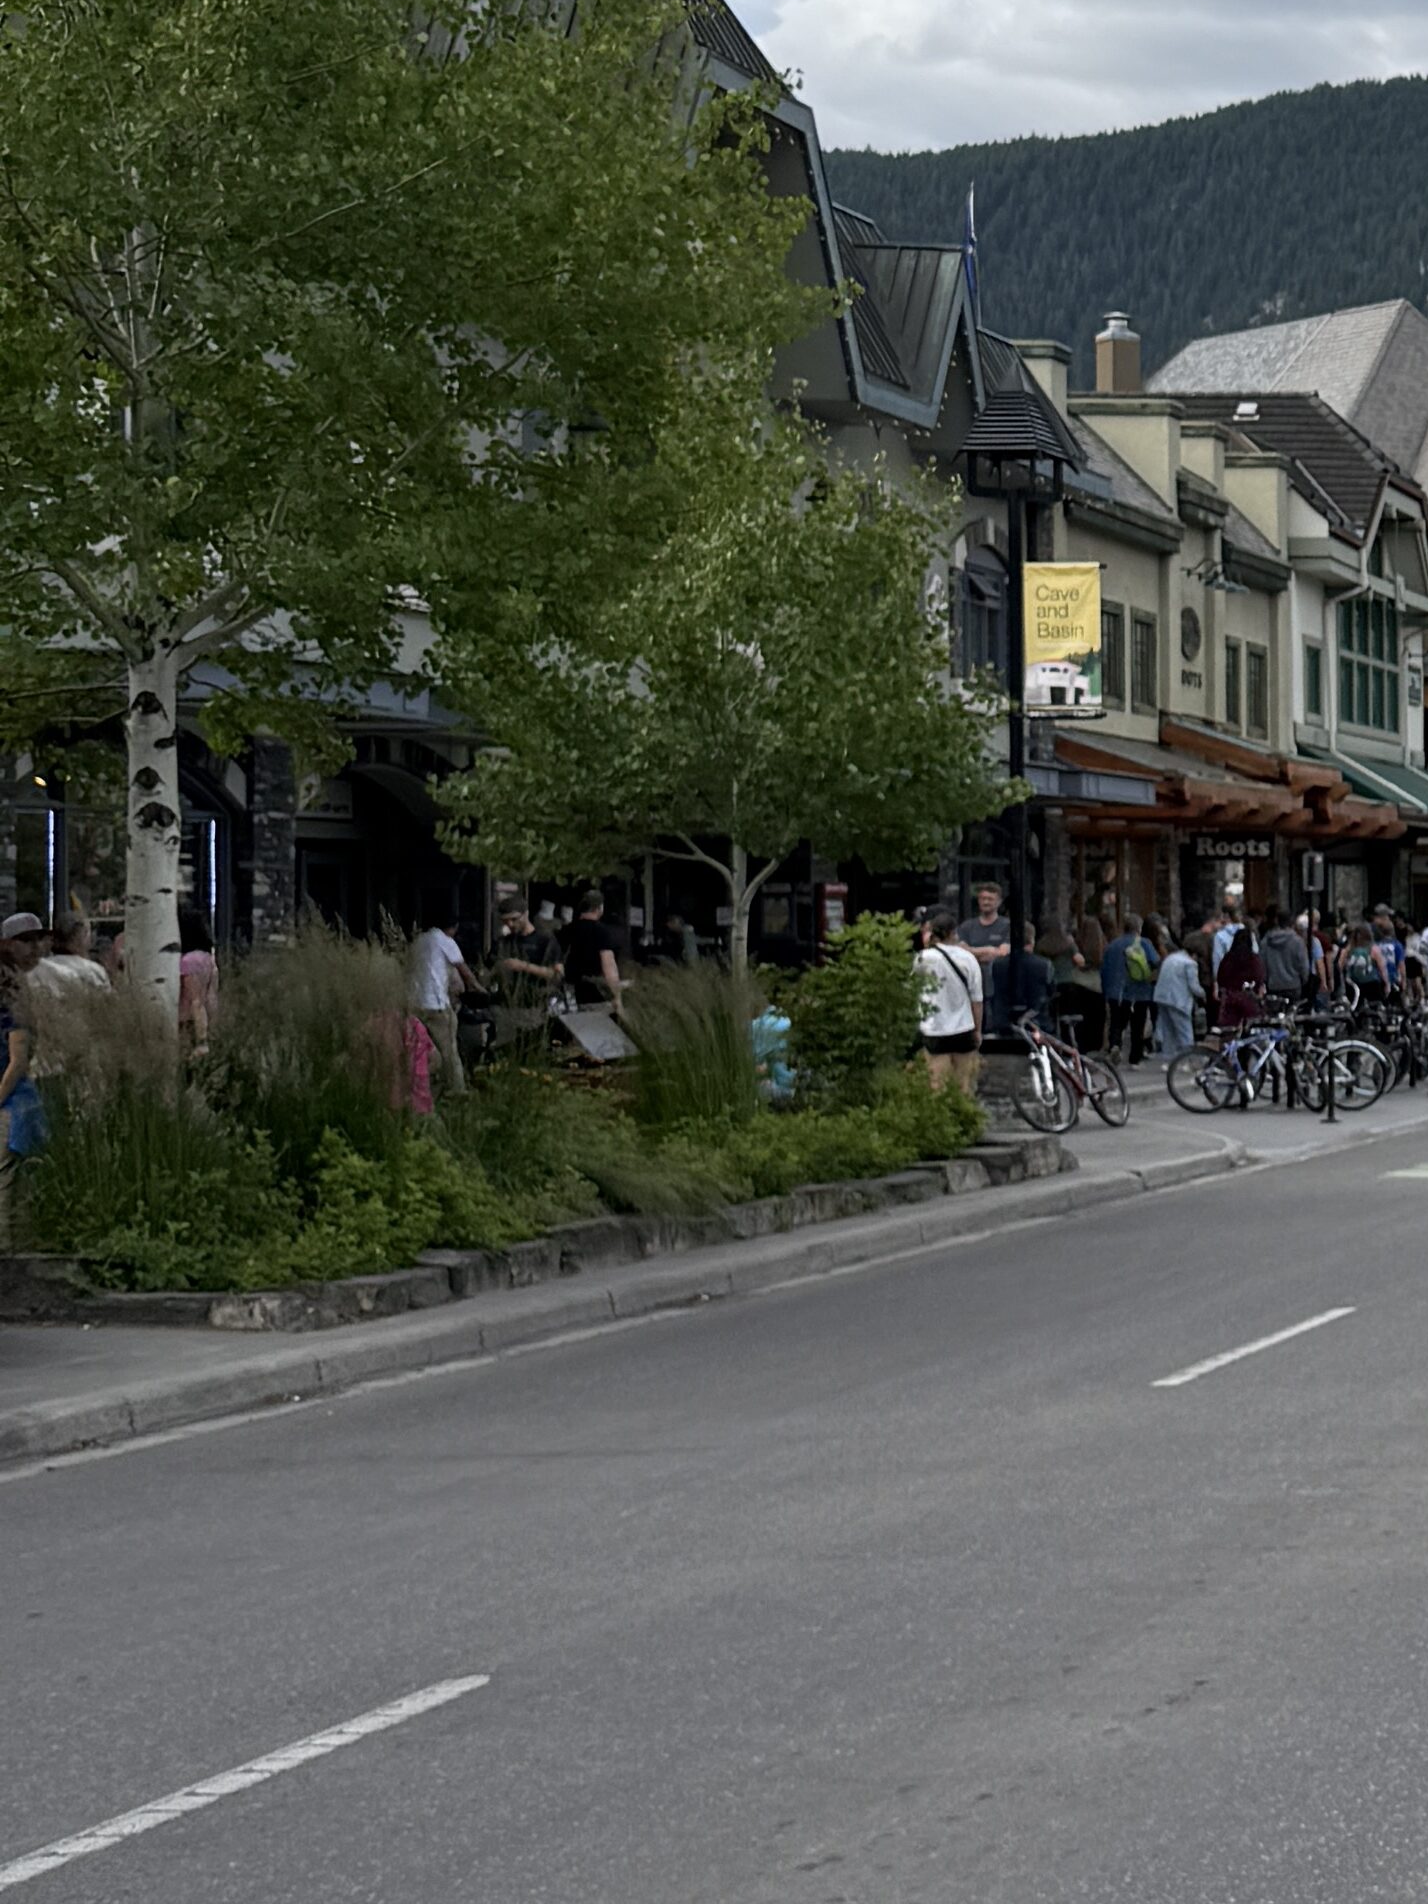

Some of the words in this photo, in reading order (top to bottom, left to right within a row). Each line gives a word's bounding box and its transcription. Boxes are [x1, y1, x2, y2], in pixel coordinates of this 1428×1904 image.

[1035, 584, 1080, 601] Cave
[1036, 604, 1069, 619] and
[1037, 622, 1085, 639] Basin
[1196, 837, 1270, 857] Roots
